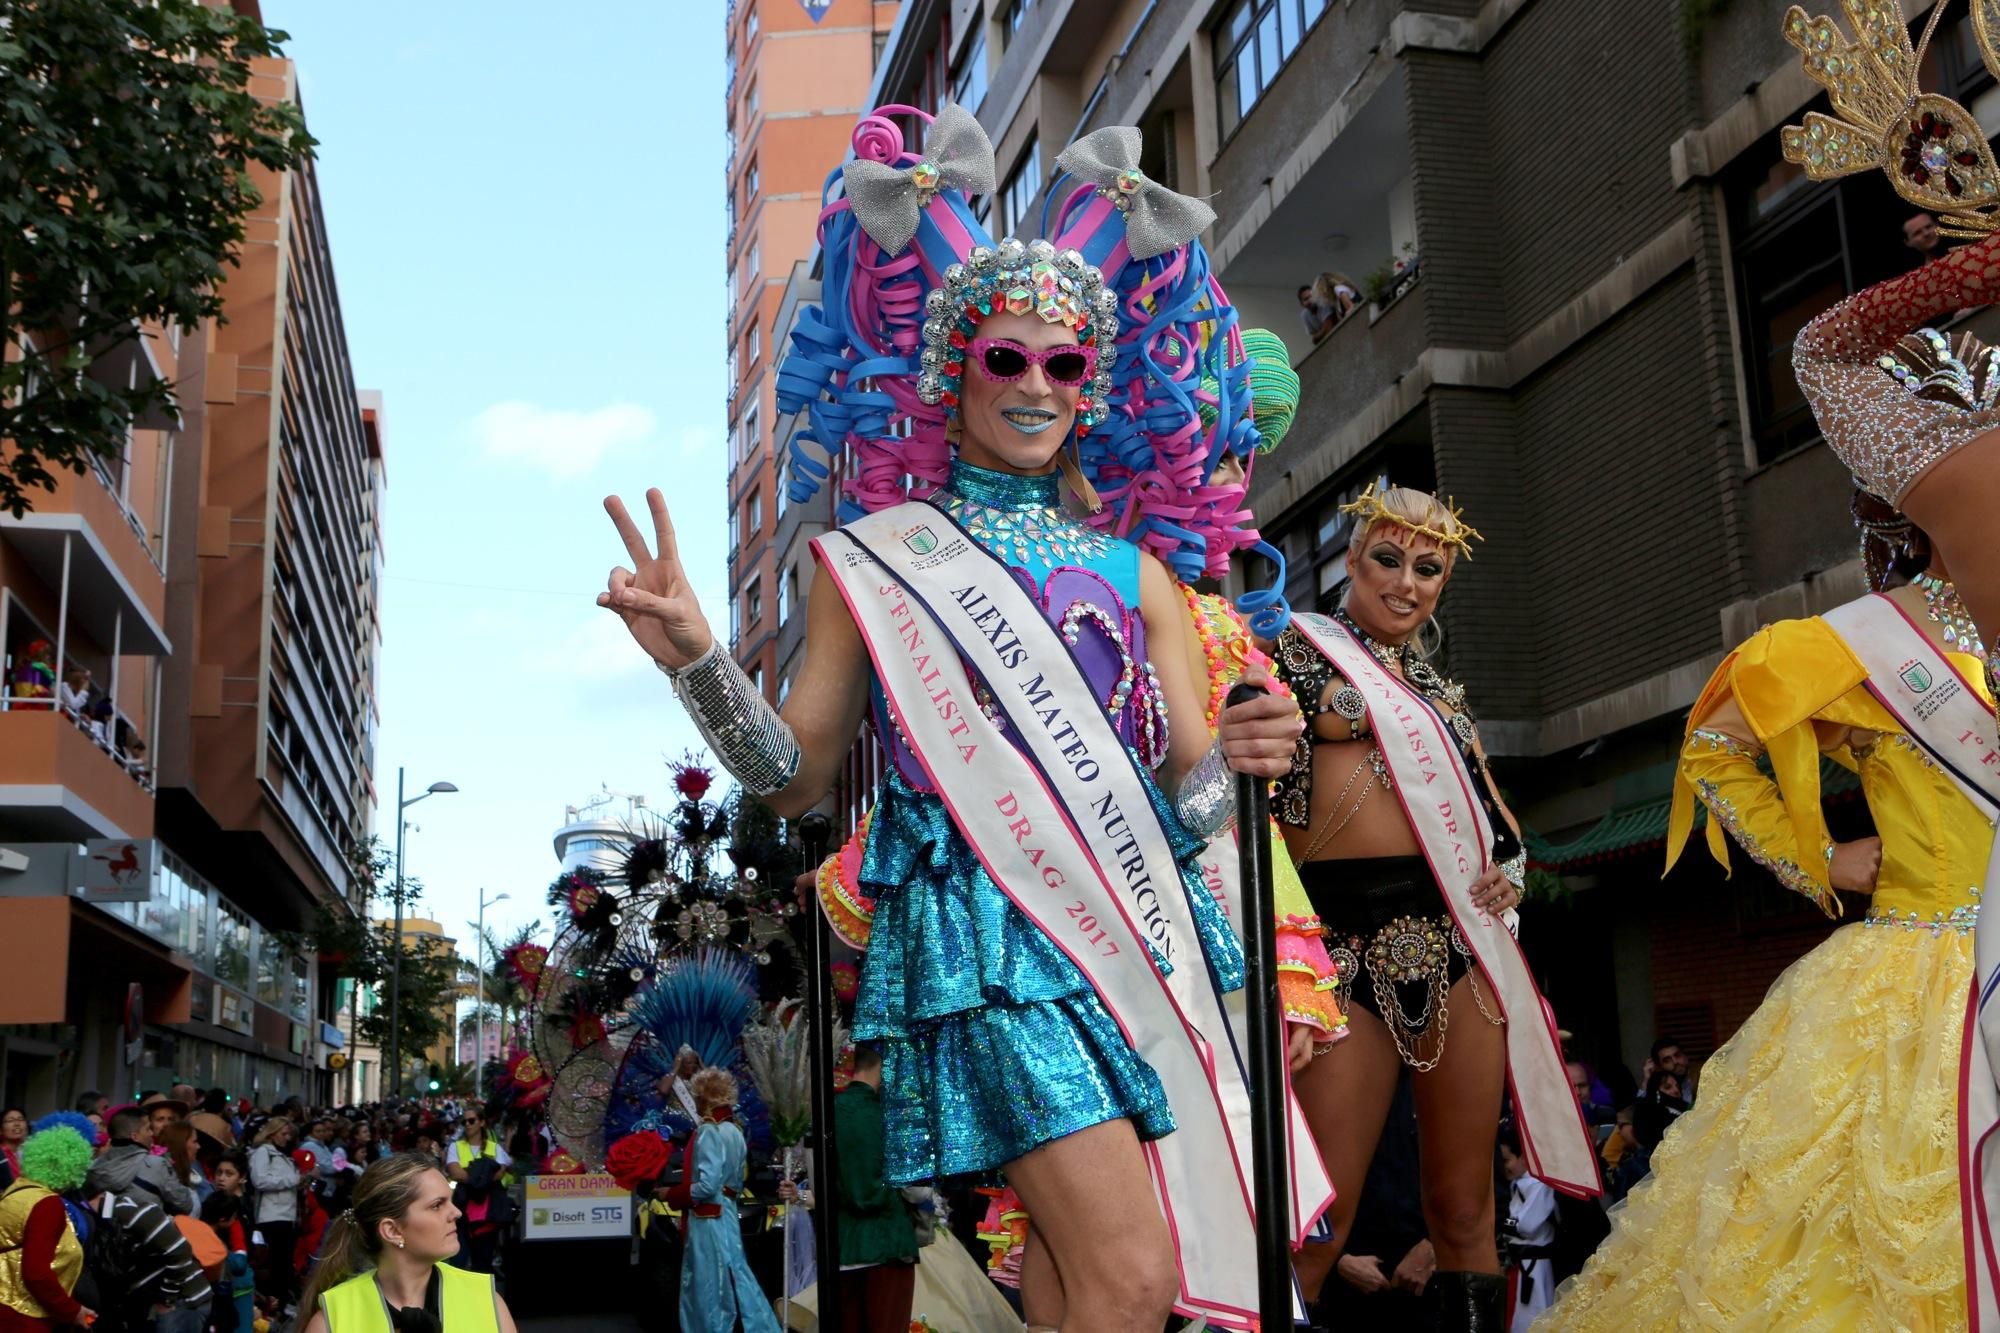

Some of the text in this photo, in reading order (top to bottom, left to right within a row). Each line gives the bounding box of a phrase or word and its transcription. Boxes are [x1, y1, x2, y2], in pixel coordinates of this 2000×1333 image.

[1913, 678, 1954, 712] Ayuntamiento
[1927, 704, 1941, 716] Gran
[1940, 686, 1961, 704] Canaria
[1936, 682, 1957, 700] Palmas
[950, 585, 1176, 960] ALEXIS MATEO NUTRICIÓN
[1438, 801, 1469, 873] DRAG
[995, 790, 1066, 889] DRAG
[1065, 900, 1120, 957] 2017
[1202, 863, 1232, 917] 2017
[538, 1177, 576, 1190] GRAN
[552, 1211, 586, 1223] Disoft
[591, 1206, 623, 1220] STG
